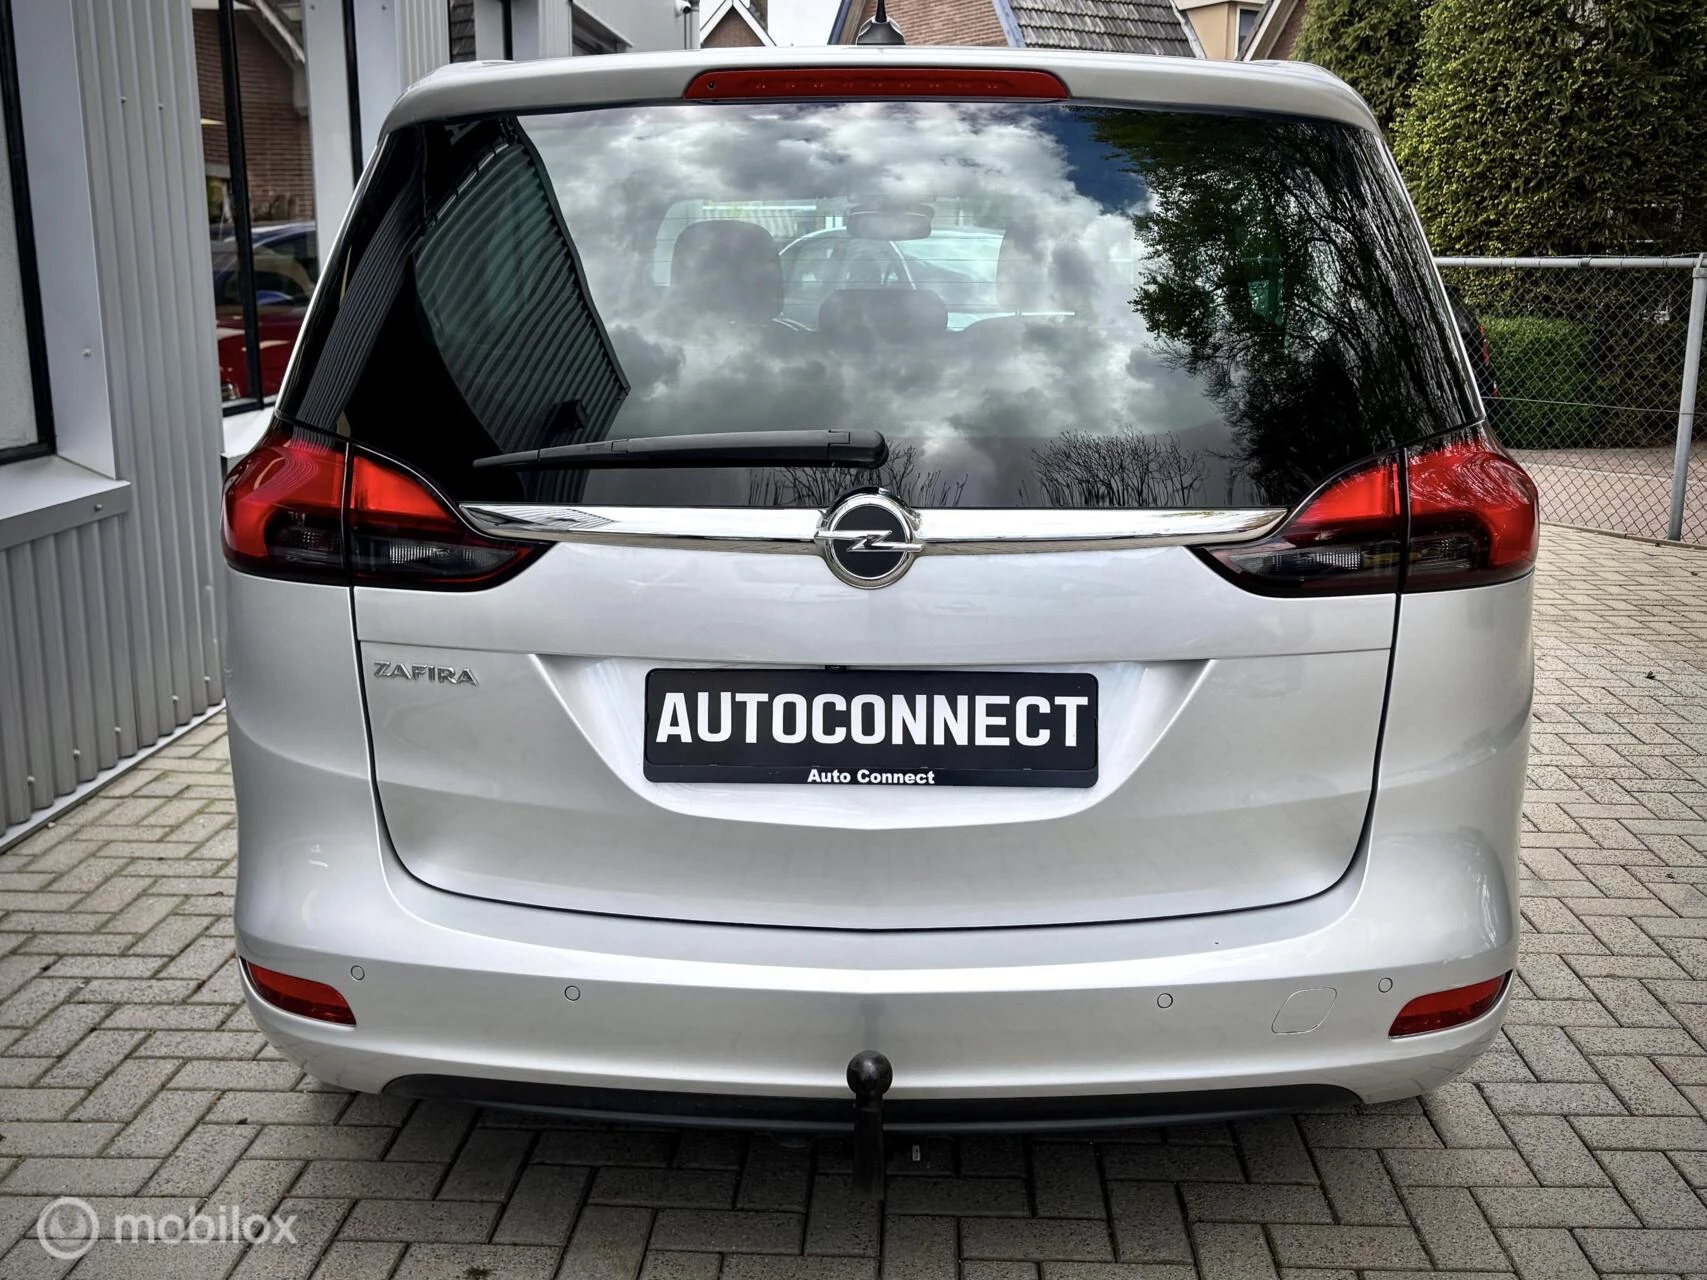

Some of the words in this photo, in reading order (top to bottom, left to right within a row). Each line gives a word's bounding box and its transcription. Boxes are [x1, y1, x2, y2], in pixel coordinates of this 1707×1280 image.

[373, 660, 480, 687] ZAFIRA
[655, 691, 1089, 747] AUTOCONNECT
[807, 768, 851, 784] Auto
[856, 769, 936, 785] Connect
